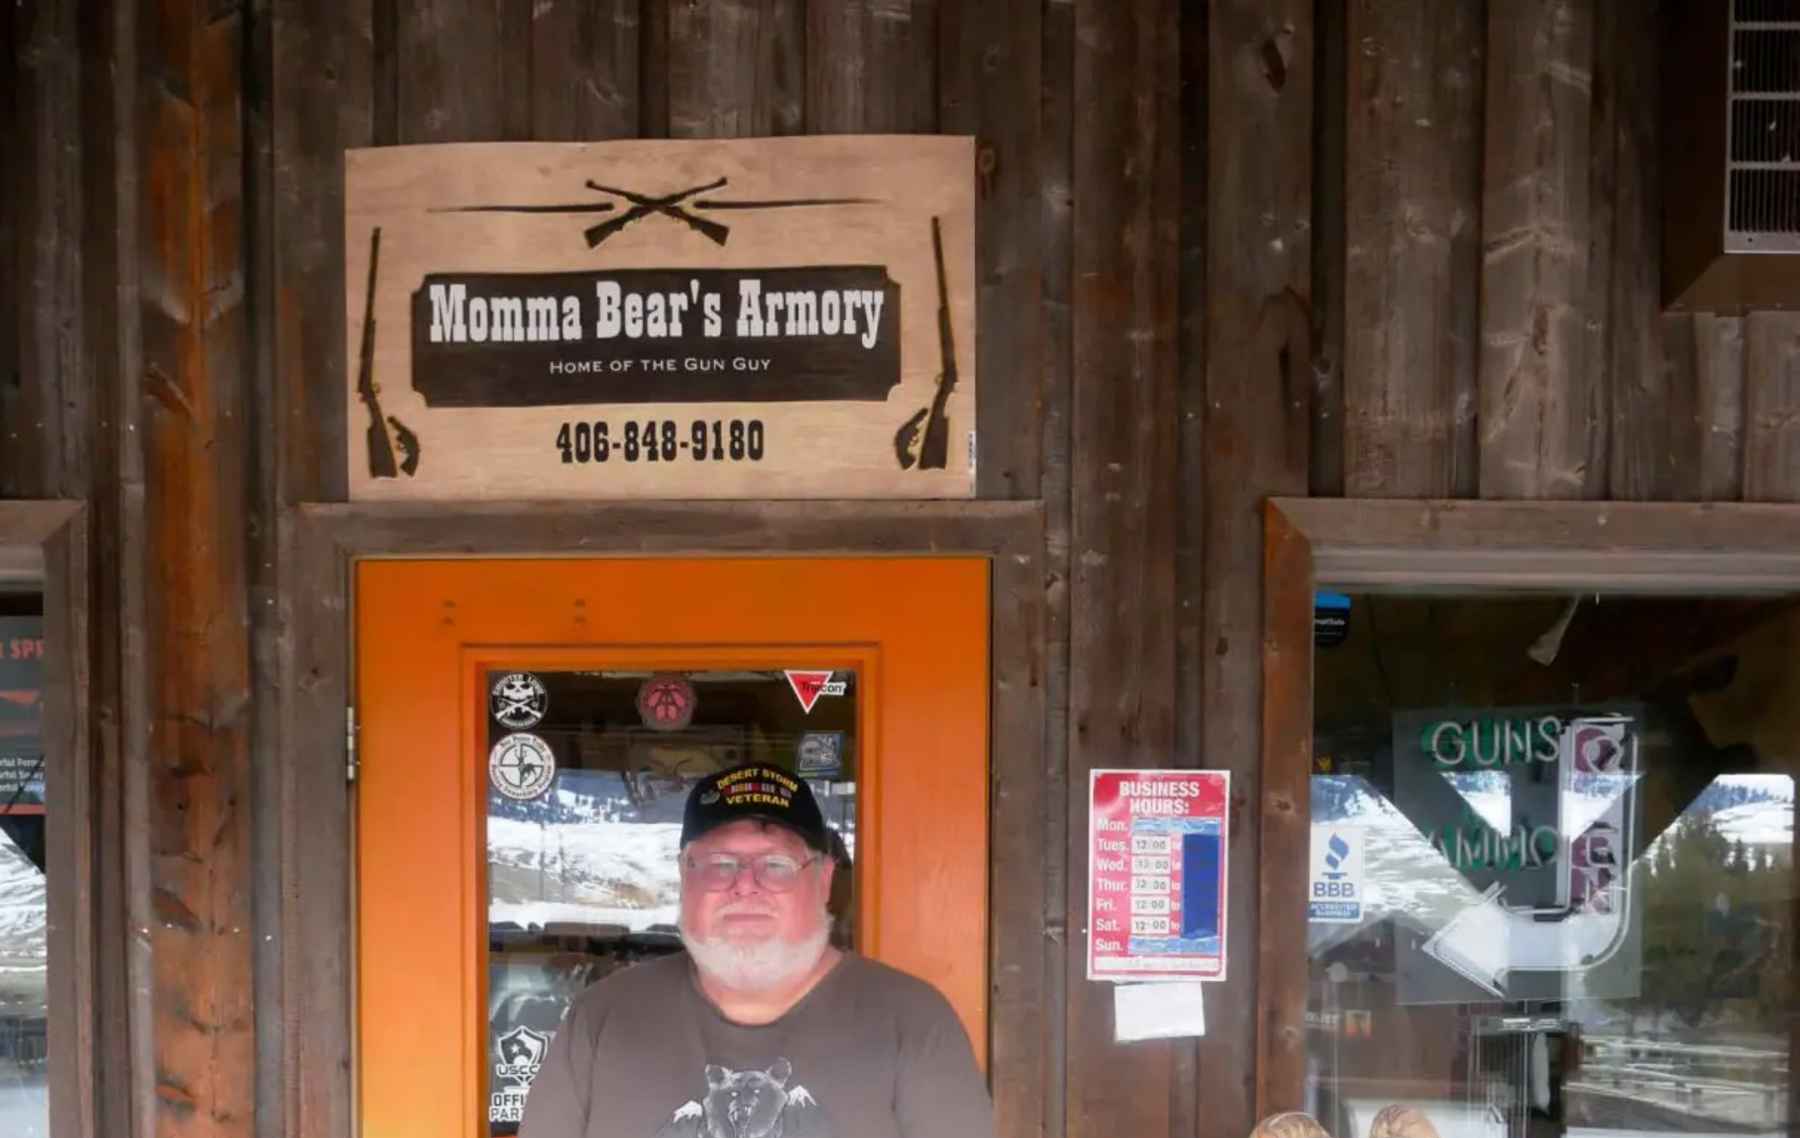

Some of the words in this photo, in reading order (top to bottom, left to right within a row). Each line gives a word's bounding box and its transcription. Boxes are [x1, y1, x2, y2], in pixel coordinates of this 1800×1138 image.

[429, 284, 583, 343] Momma
[596, 279, 722, 338] Bear's
[736, 279, 885, 349] Armory
[549, 360, 603, 375] HOME
[609, 359, 634, 373] OF
[640, 358, 678, 372] THE
[684, 357, 726, 371] GUN
[732, 356, 772, 371] GUY
[556, 419, 765, 463] 406-848-9180
[1431, 715, 1562, 767] GUNS
[716, 768, 759, 790] DESERT
[761, 768, 798, 792] STORM
[1119, 780, 1201, 798] BUSINESS
[726, 793, 790, 808] VETERAN
[1129, 798, 1191, 815] HOURS:
[1096, 817, 1128, 831] Mon.
[1096, 838, 1129, 851] Tues.
[1096, 859, 1129, 872] Wed.
[1096, 878, 1129, 892] Thur.
[1313, 882, 1355, 897] BBB
[1096, 898, 1117, 911] Fri.
[1096, 919, 1121, 932] Sat.
[1096, 939, 1124, 952] Sun.
